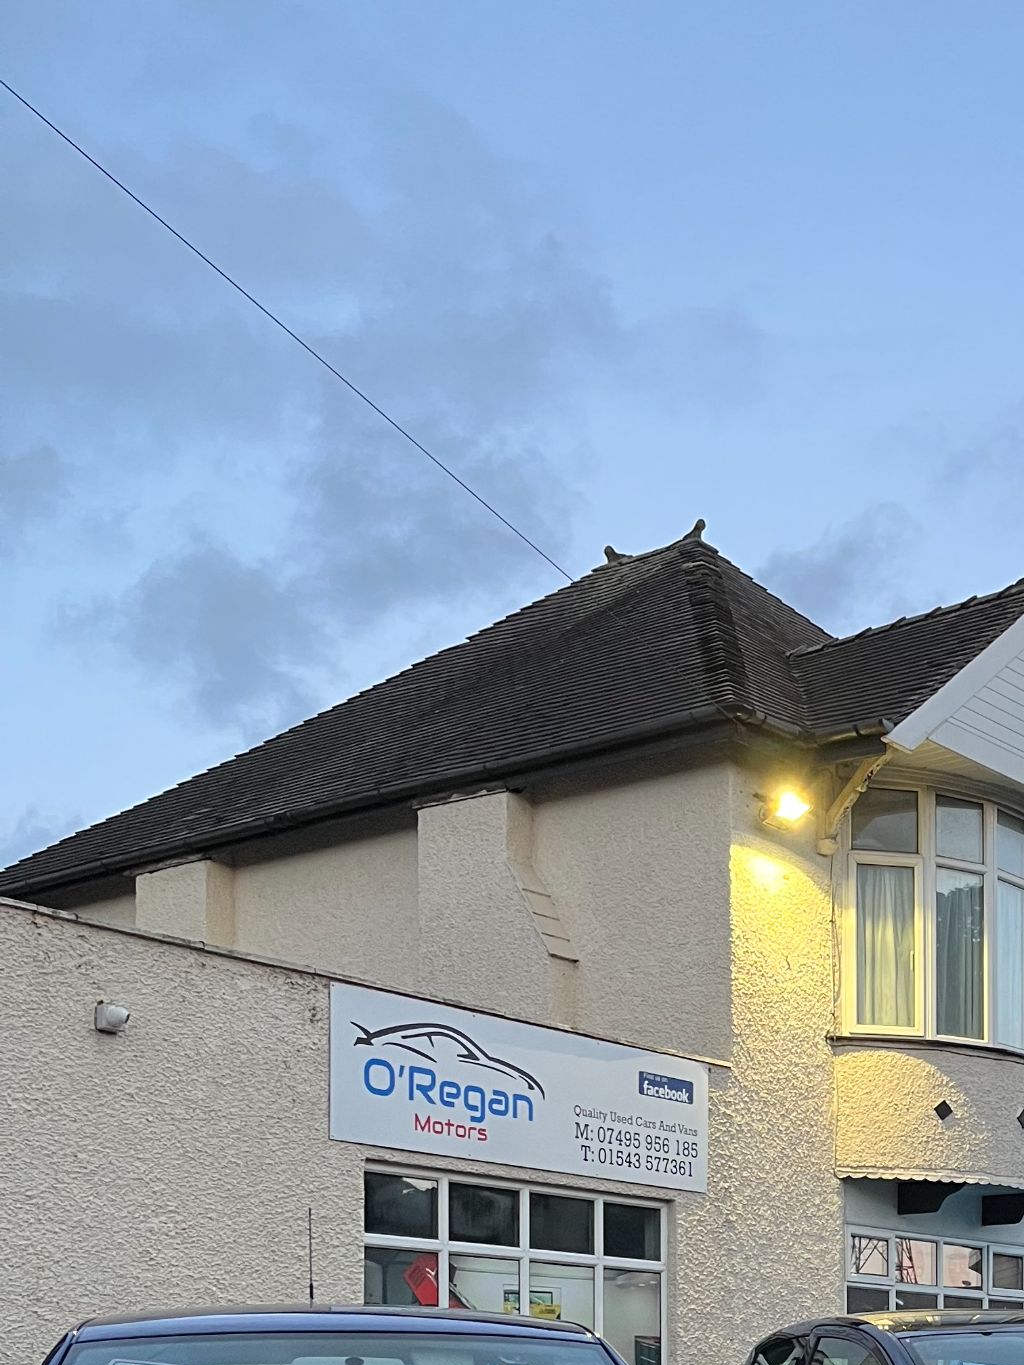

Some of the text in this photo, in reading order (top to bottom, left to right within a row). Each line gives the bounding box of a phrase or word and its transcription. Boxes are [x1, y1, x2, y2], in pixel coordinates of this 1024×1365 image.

[364, 1058, 533, 1123] O'Regan
[643, 1080, 689, 1103] facebook
[414, 1114, 488, 1141] Motors
[573, 1104, 698, 1137] Quality Used Cars And Vans
[575, 1122, 698, 1158] M: 07495 956 185
[580, 1145, 693, 1177] T: 01543 577361
